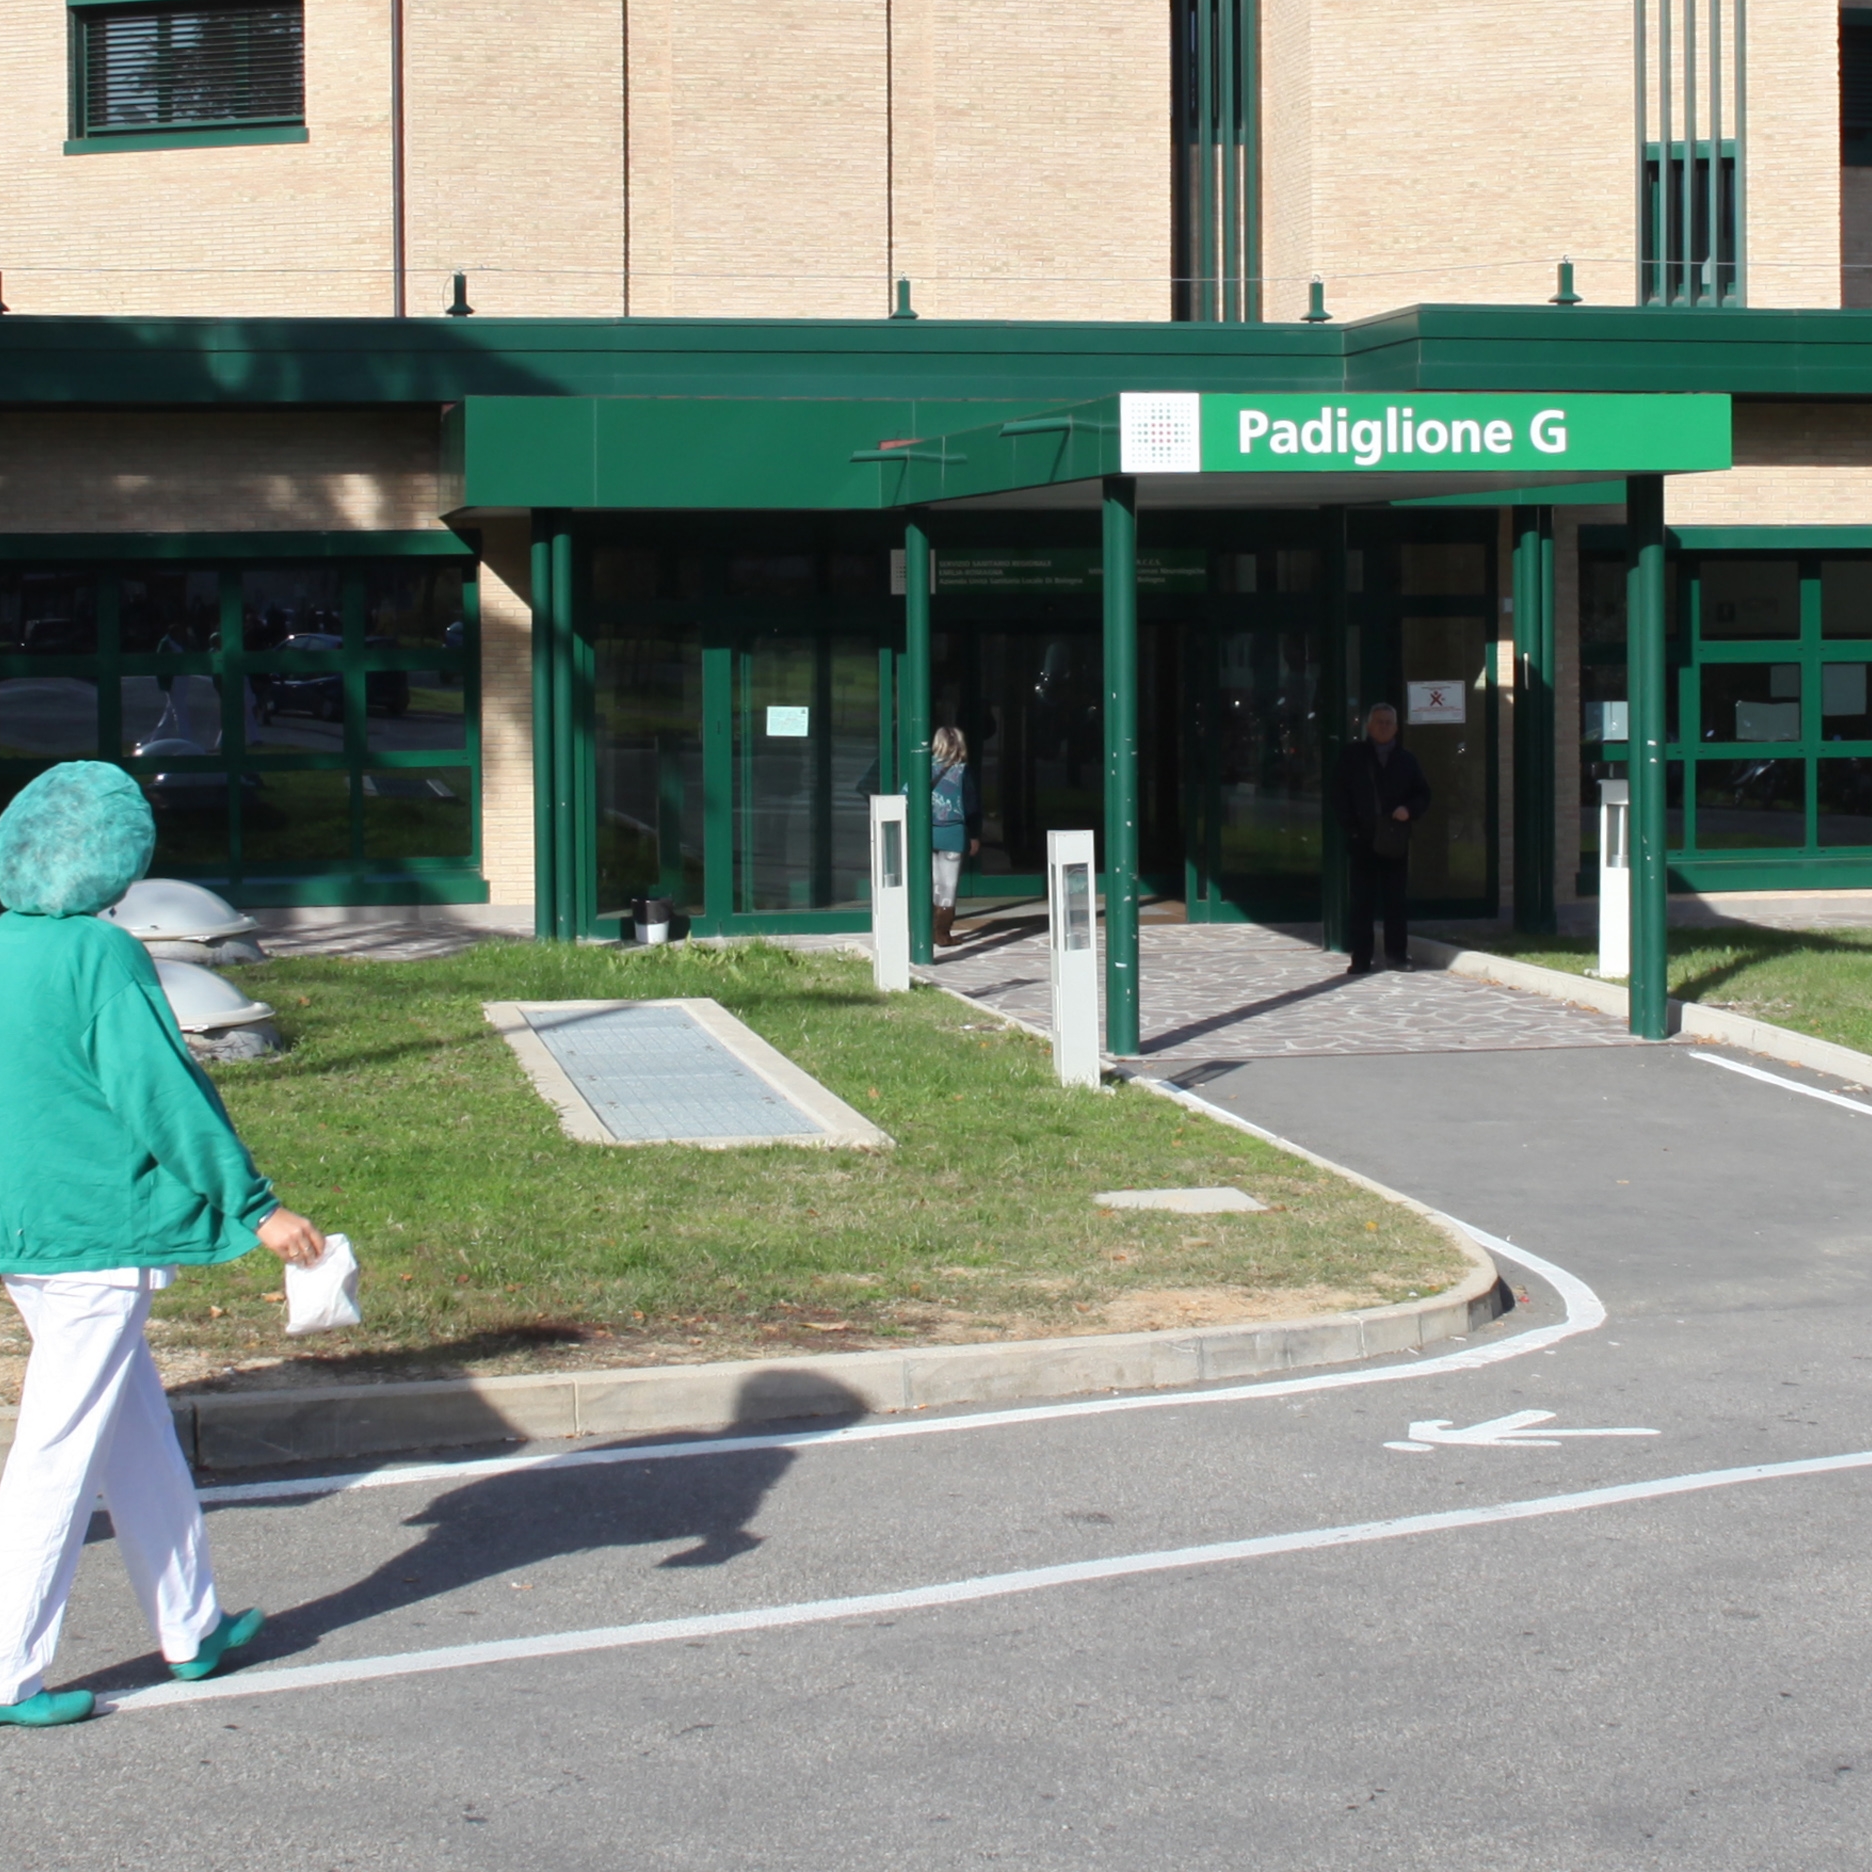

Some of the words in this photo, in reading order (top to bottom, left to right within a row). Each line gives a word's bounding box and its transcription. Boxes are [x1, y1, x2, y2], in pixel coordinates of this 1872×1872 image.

[1239, 406, 1514, 466] Padiglione
[1529, 409, 1567, 453] G
[939, 560, 970, 568] SERVIZIO
[972, 560, 1010, 568] SANITARIO
[1012, 560, 1051, 568] REGIONALE
[1022, 577, 1043, 585] Locale
[1055, 577, 1083, 586] Bologna
